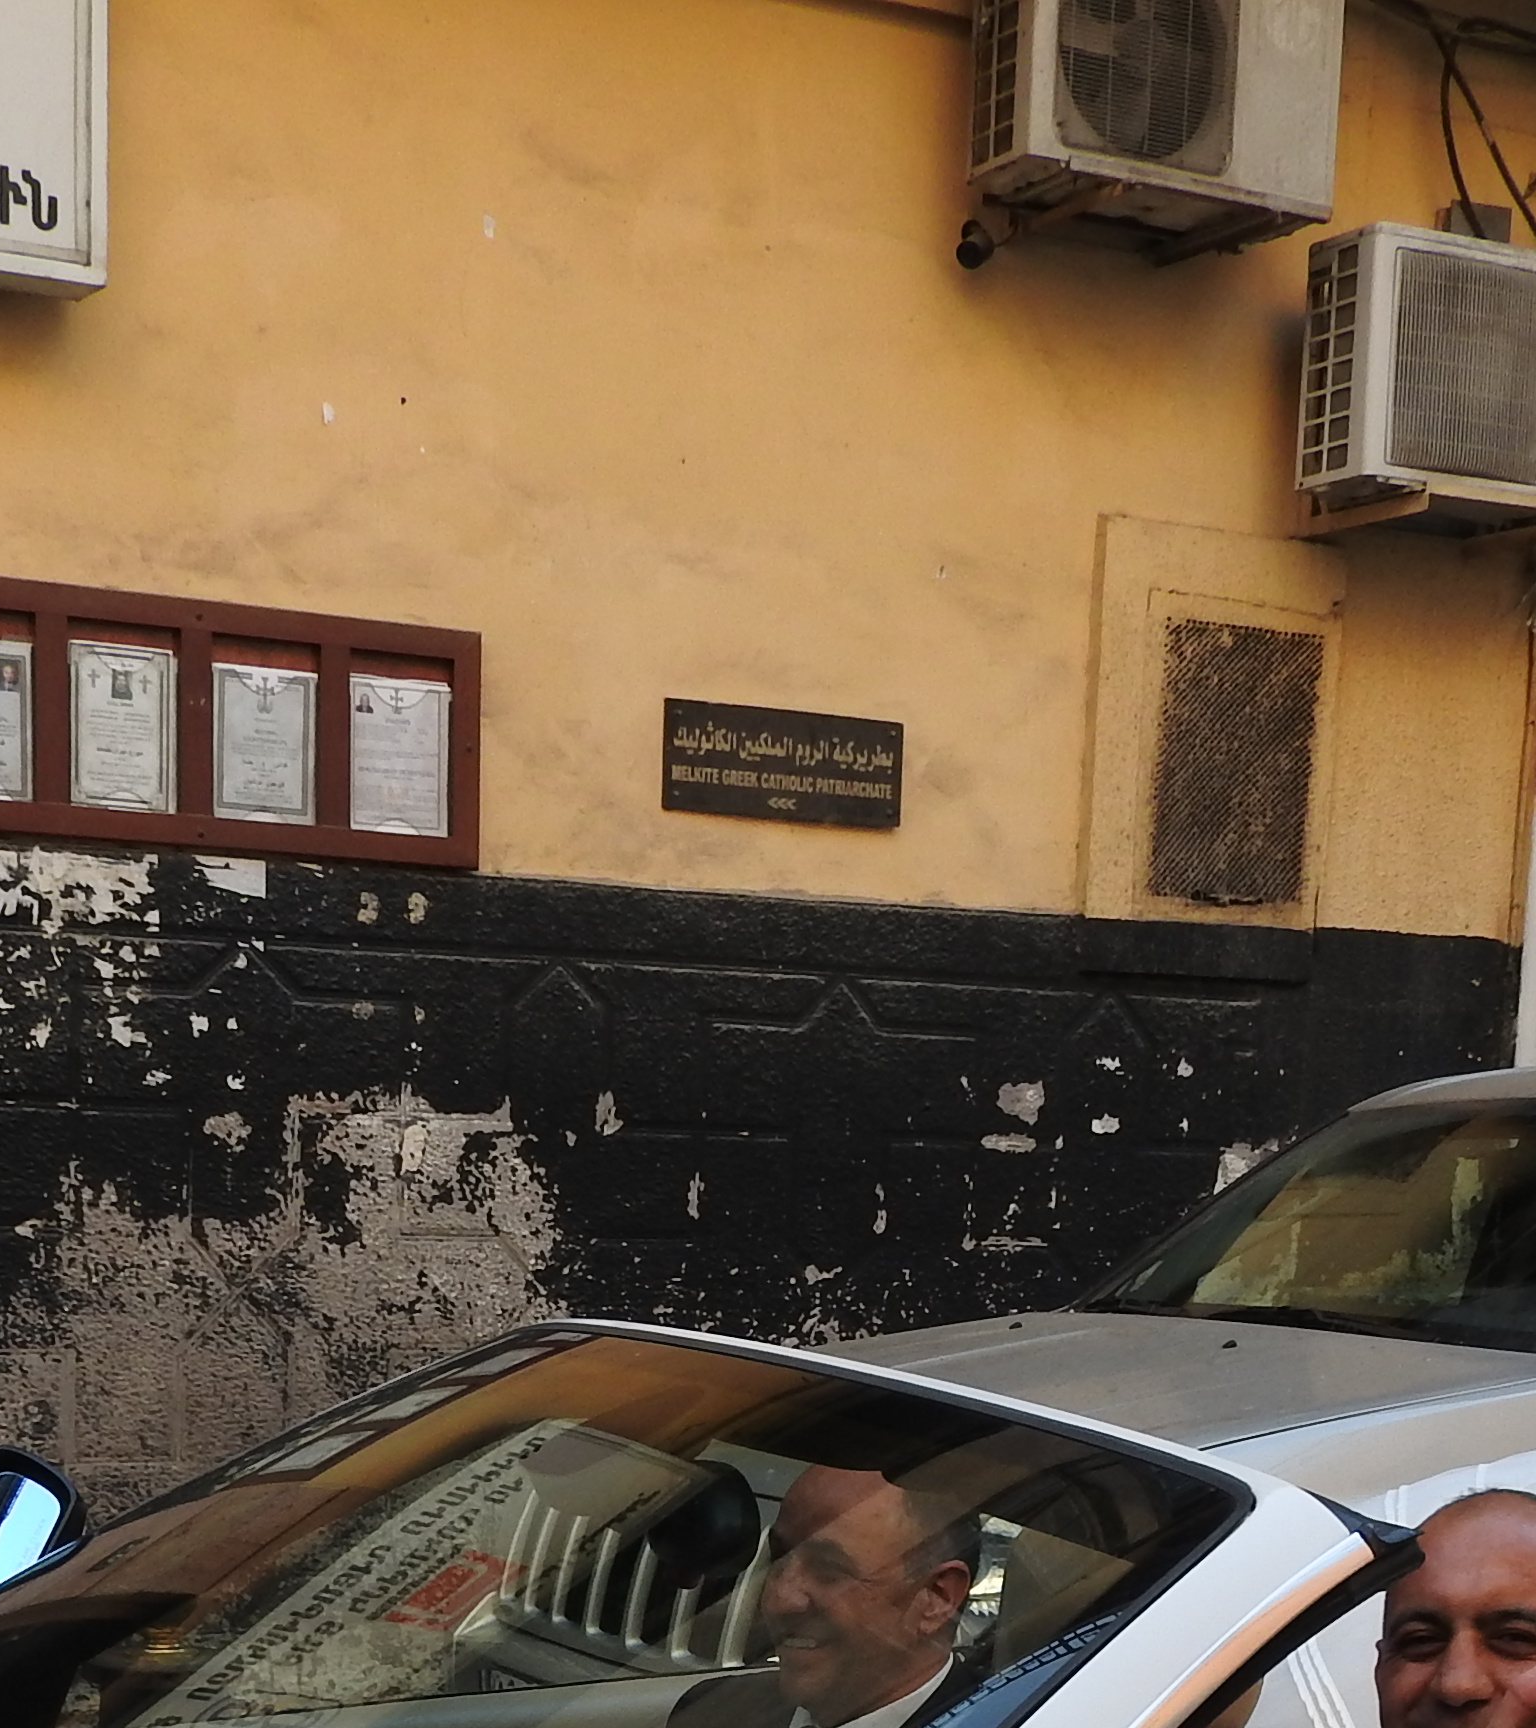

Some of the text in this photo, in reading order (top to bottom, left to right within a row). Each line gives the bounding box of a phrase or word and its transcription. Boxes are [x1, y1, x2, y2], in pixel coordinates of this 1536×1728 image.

[795, 740, 830, 767] الروم
[671, 764, 893, 800] MELKITE GREEK CATHOLIC PATRIARCHATE
